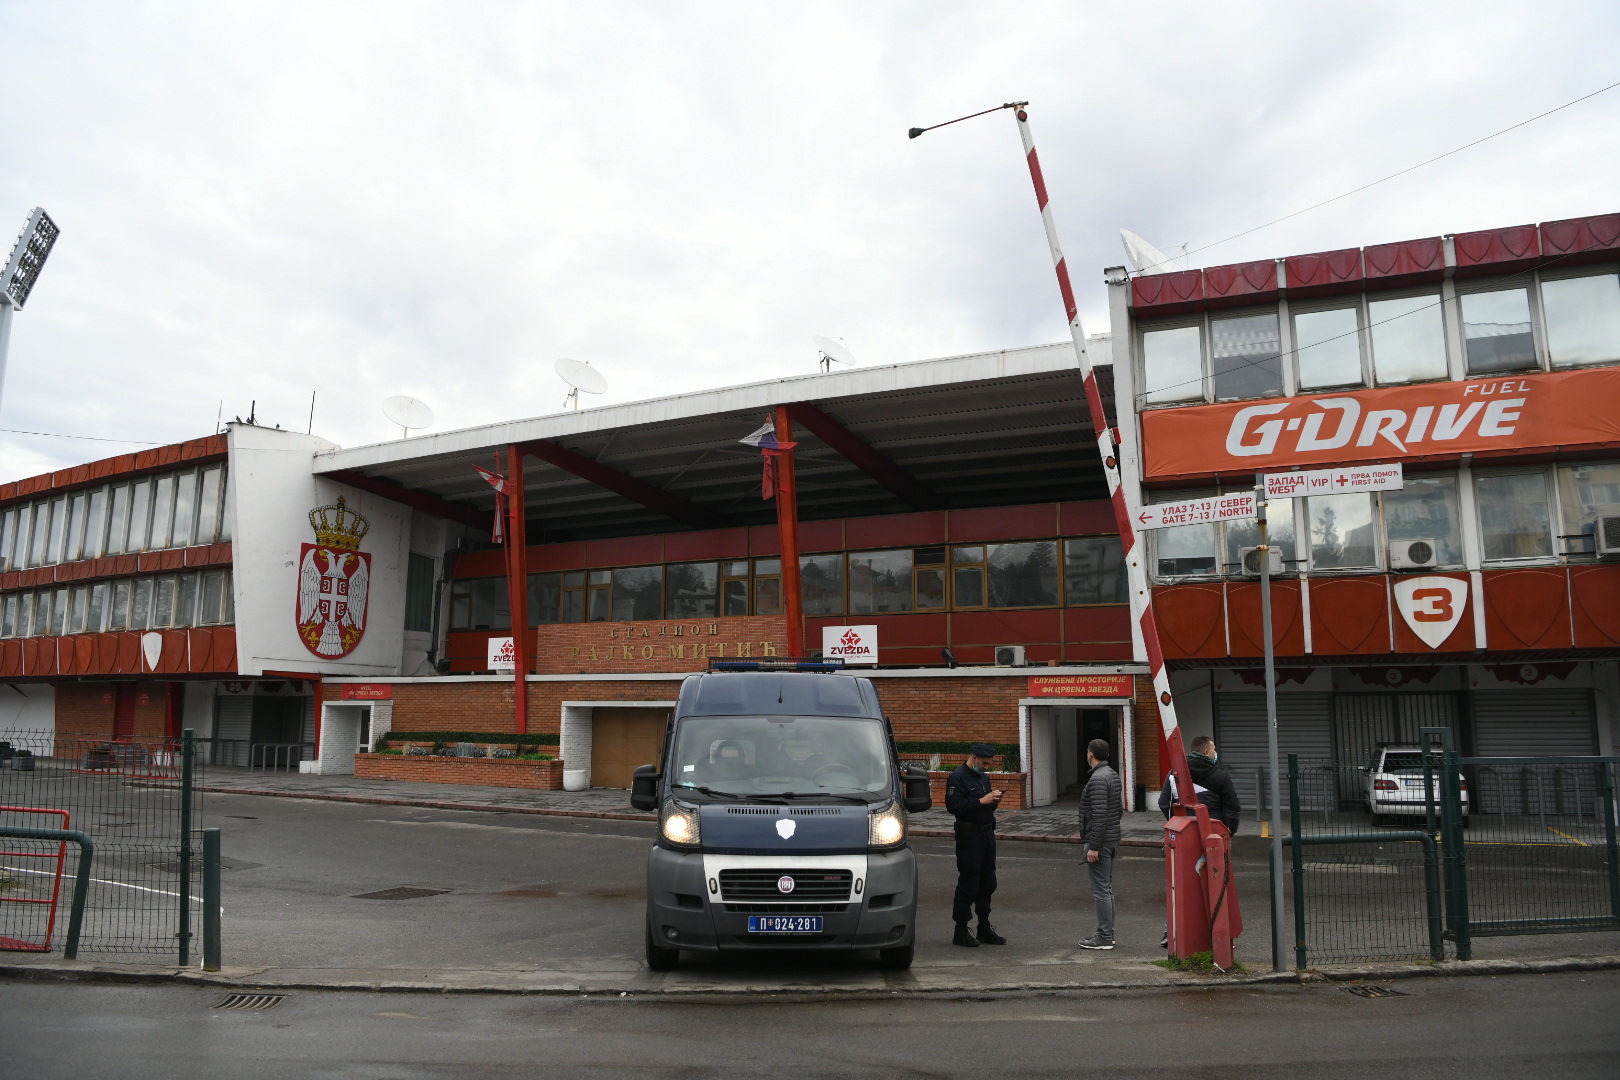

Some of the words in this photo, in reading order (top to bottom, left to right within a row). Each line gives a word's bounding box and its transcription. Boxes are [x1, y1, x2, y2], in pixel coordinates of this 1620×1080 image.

[1463, 380, 1531, 397] FUEL
[1351, 472, 1371, 480] ПРВА
[1372, 470, 1399, 479] ПОМОЋ
[1268, 475, 1305, 487] ЗАПАД
[1311, 478, 1329, 488] VIP
[1351, 478, 1372, 486] FIRST
[1373, 477, 1386, 485] AID
[1268, 485, 1297, 495] WEST
[1162, 504, 1188, 515] УЛАЗ
[1190, 502, 1212, 512] 7-13
[1220, 497, 1253, 509] СЕВЕР
[1162, 514, 1187, 525] GATE
[1189, 511, 1210, 522] 7-13
[1219, 506, 1253, 518] NORTH
[1412, 587, 1454, 622] 3
[610, 624, 719, 639] СТАДИОН
[570, 645, 655, 662] РАЈКО
[669, 641, 778, 660] МИТИЋ
[830, 645, 871, 655] ZVEZDA
[1390, 672, 1397, 680] 3
[1524, 667, 1533, 677] 3
[1055, 686, 1086, 694] ЦРВЕНА
[1087, 685, 1119, 693] ЗВЕЗДА
